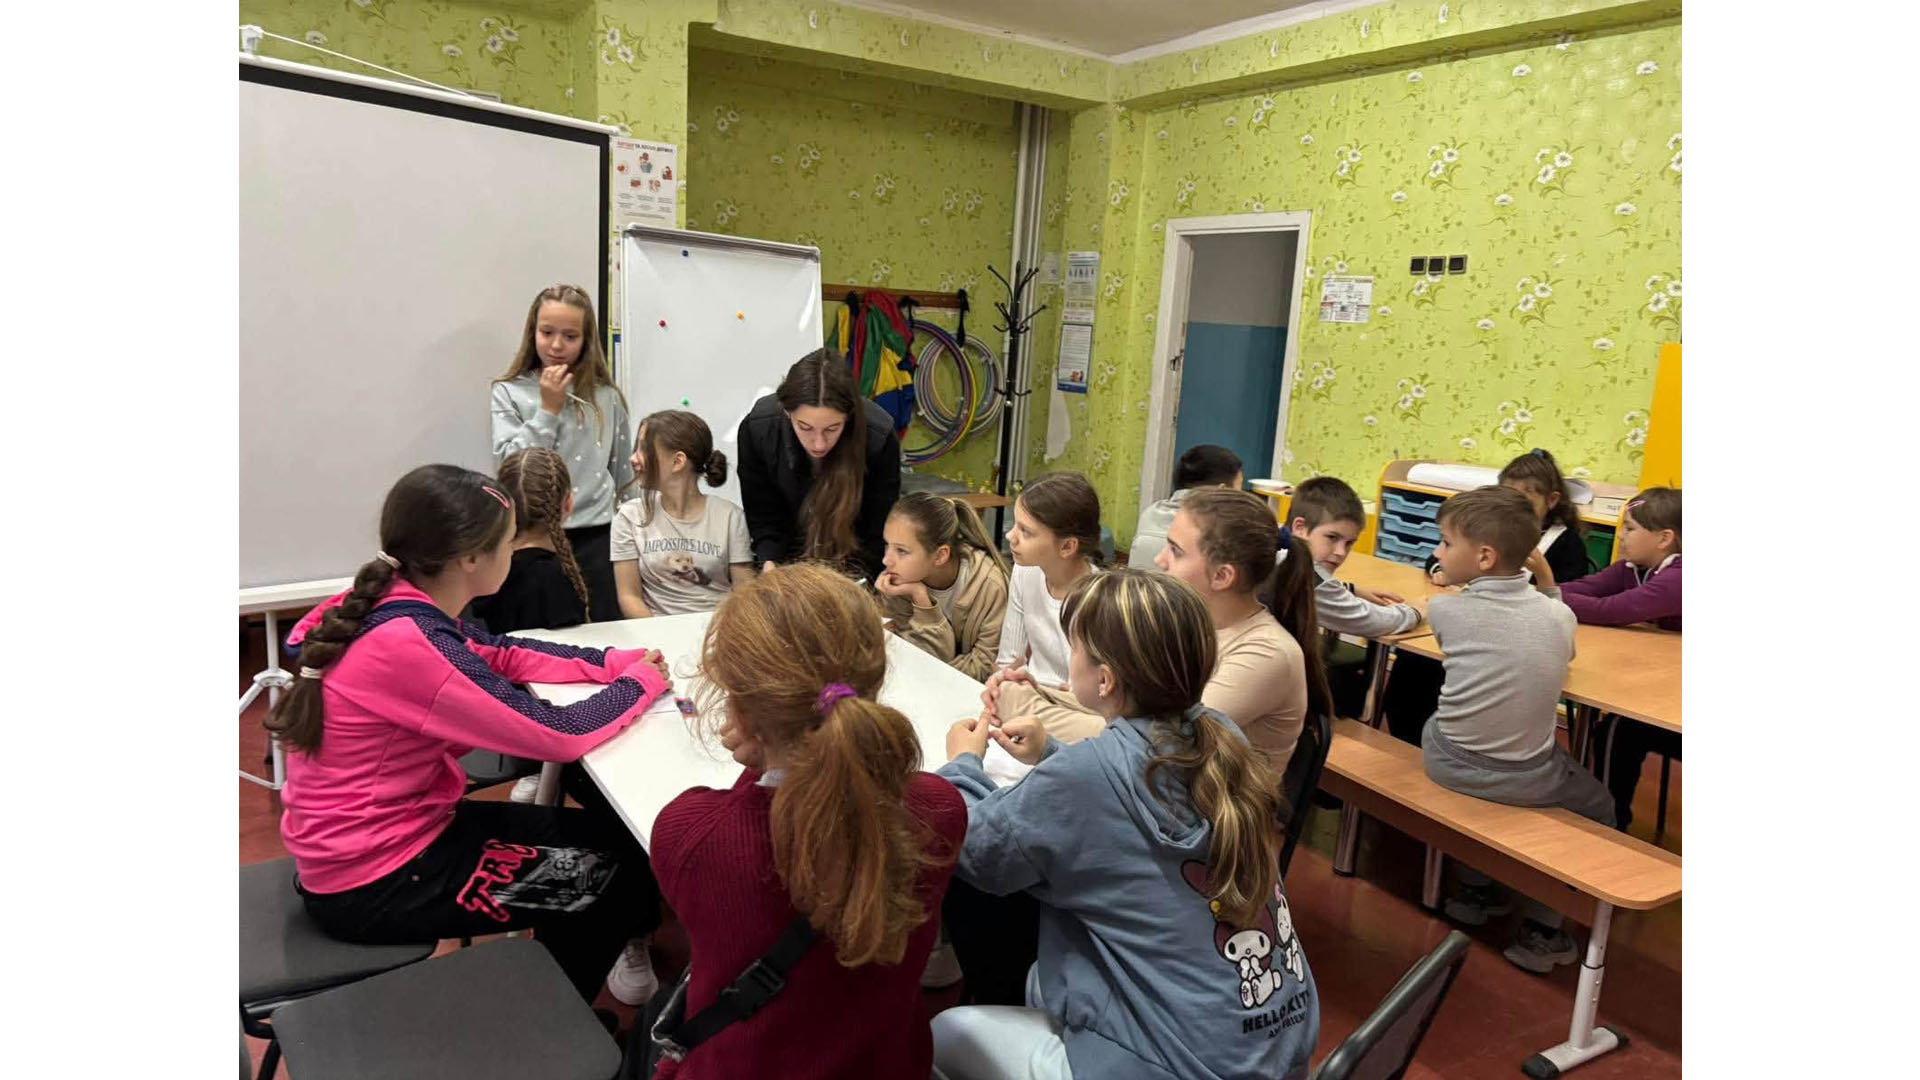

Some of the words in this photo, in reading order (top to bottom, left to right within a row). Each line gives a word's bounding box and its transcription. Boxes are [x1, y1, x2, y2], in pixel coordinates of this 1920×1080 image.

[643, 537, 697, 554] IMPOSSIBLE
[697, 540, 724, 559] LOVE
[1242, 1005, 1287, 1034] HELLO
